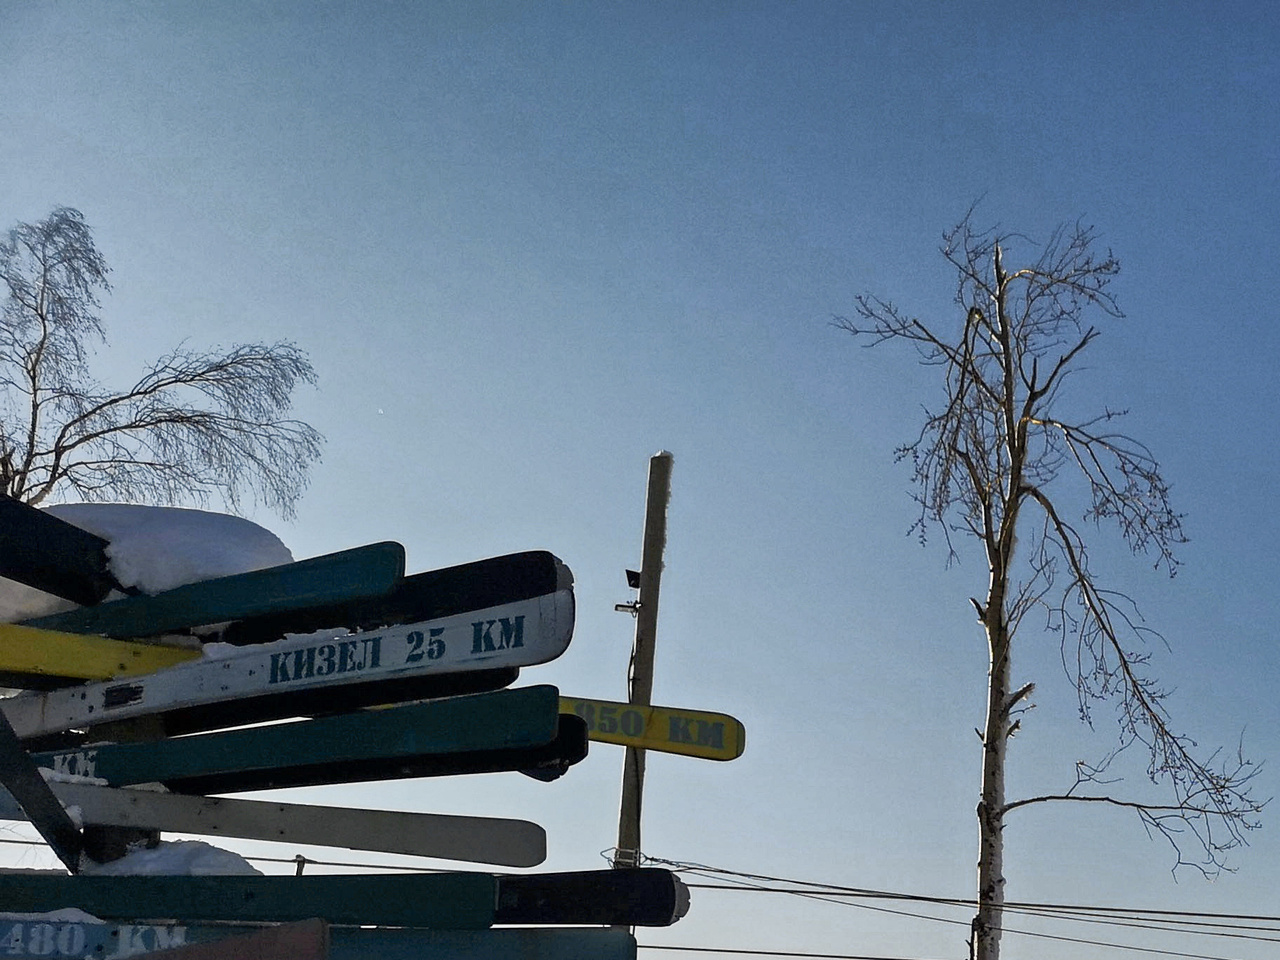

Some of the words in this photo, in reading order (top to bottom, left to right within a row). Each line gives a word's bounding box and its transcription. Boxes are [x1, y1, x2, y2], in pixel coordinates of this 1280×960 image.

[269, 636, 383, 684] КИЗЕЛ
[406, 627, 446, 663] 25
[470, 615, 526, 654] КМ
[669, 716, 725, 749] КМ
[0, 923, 87, 955] 480
